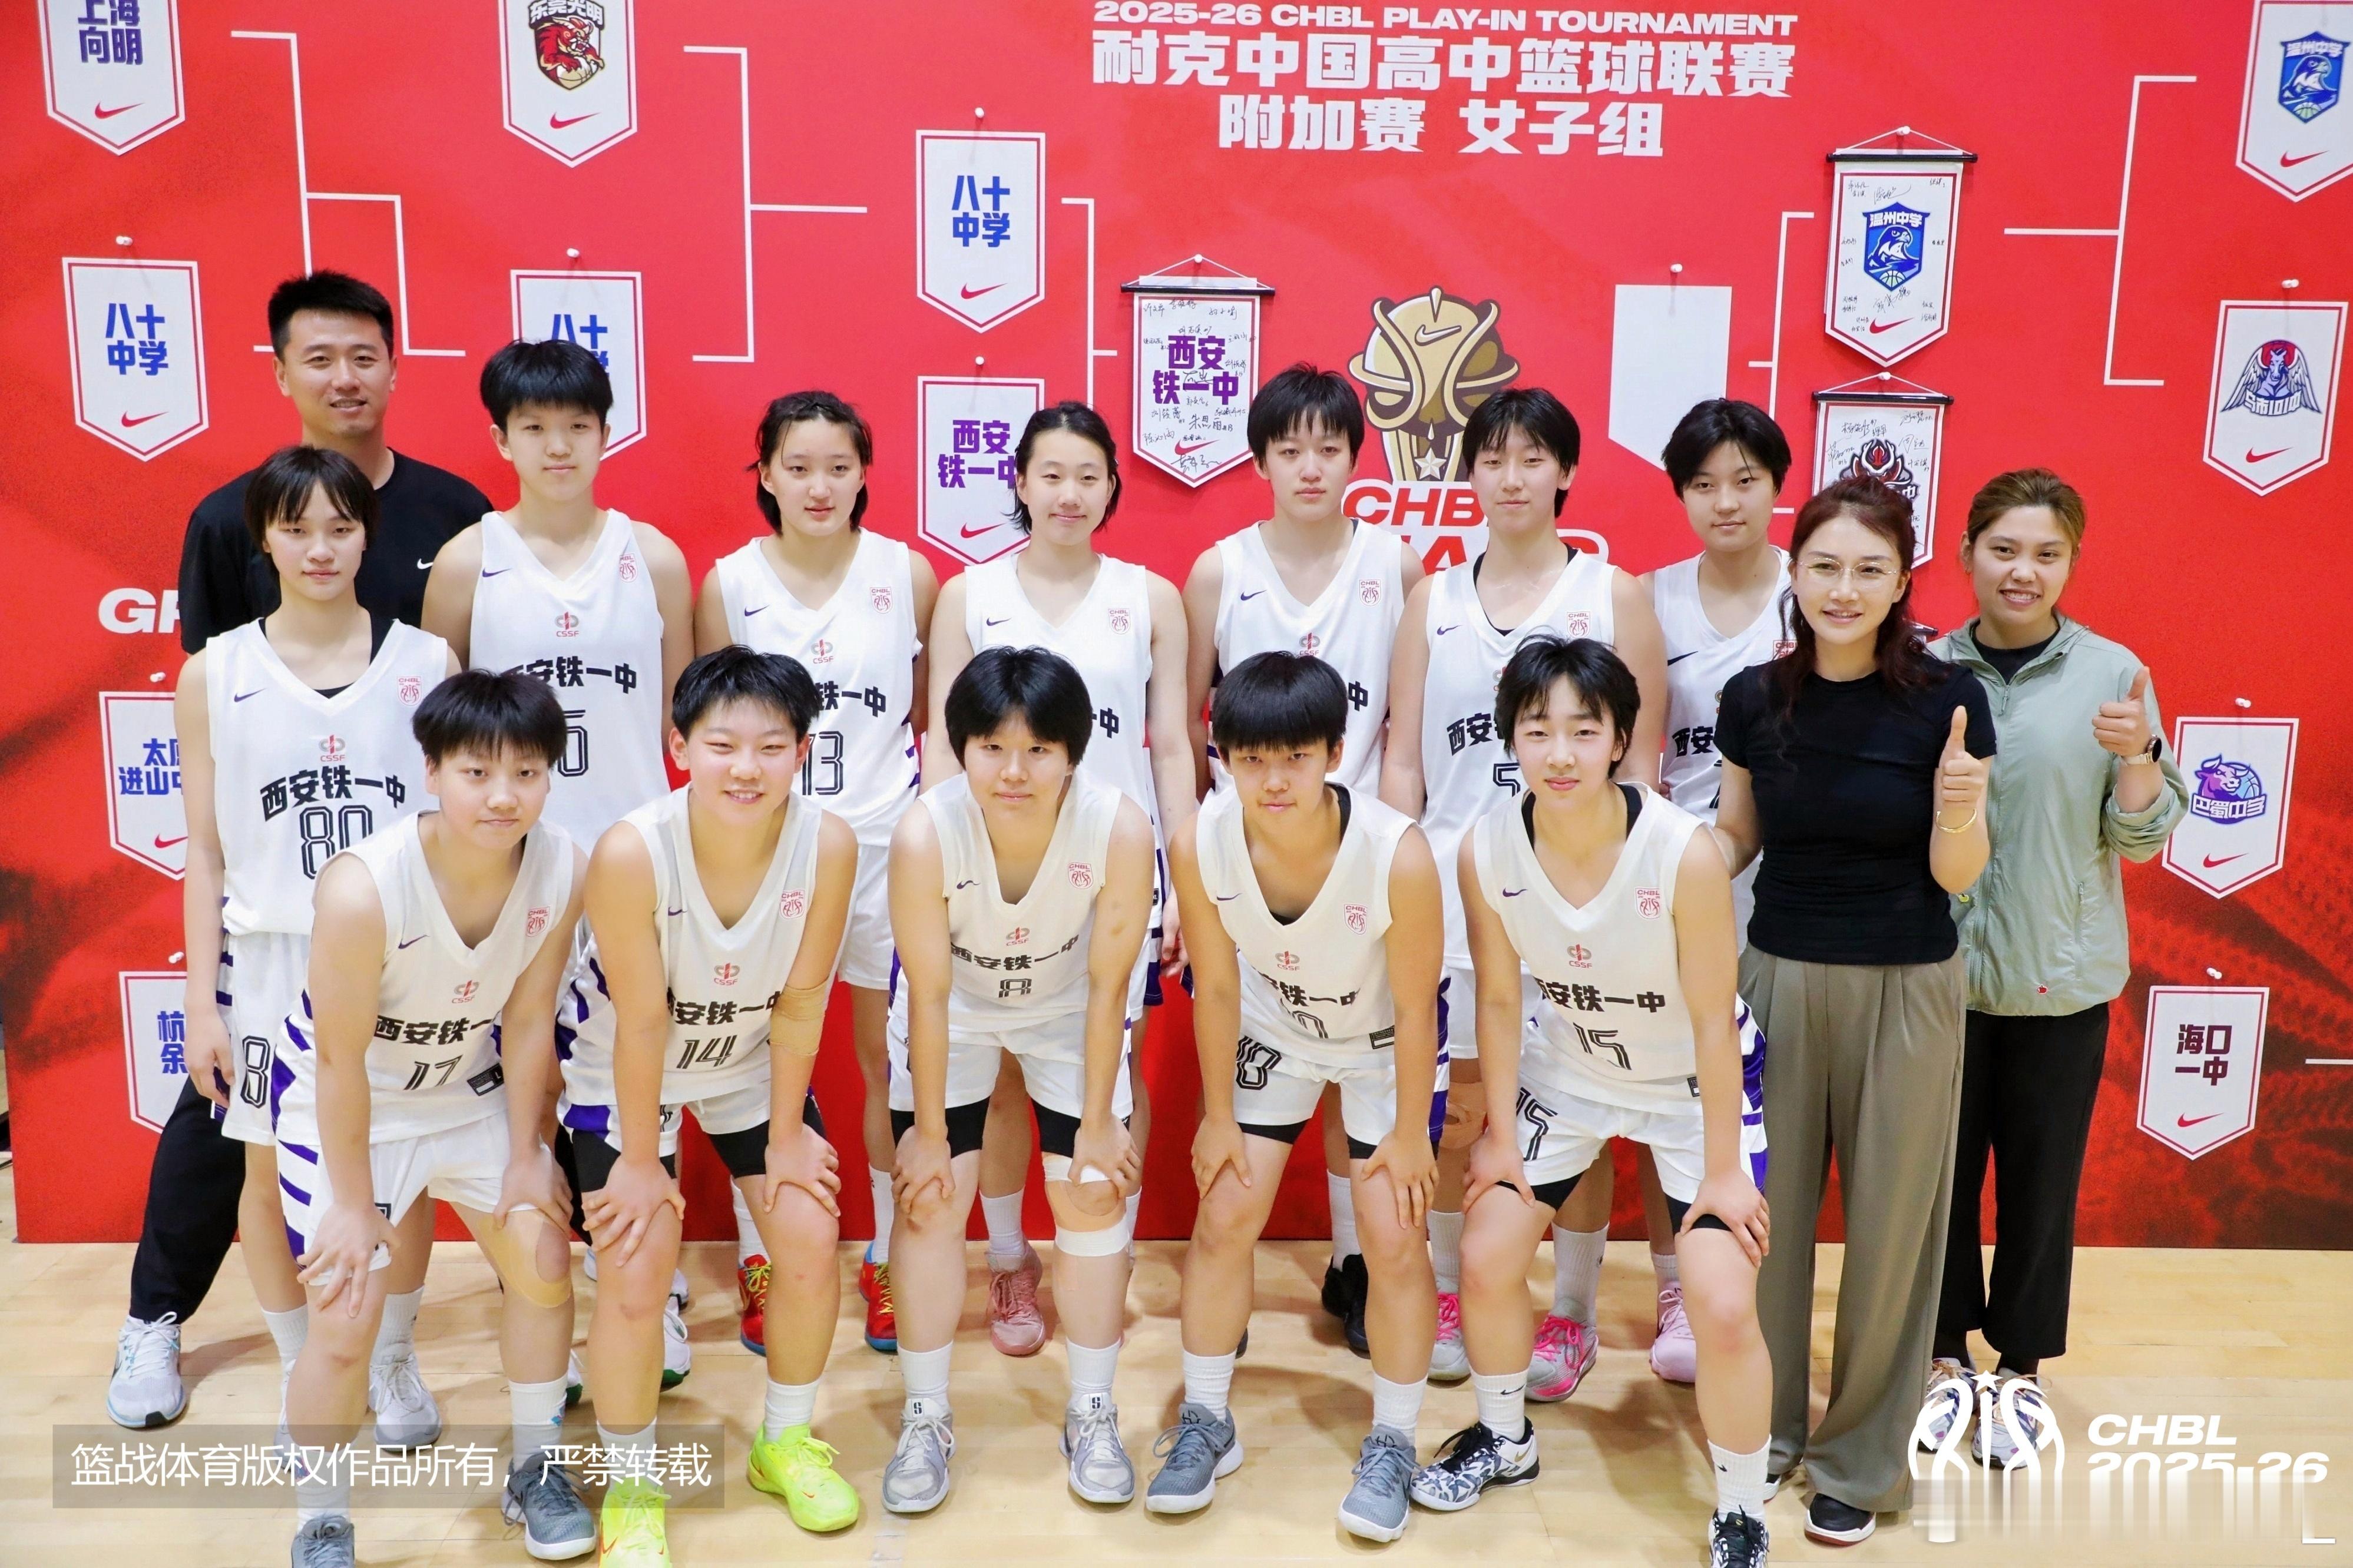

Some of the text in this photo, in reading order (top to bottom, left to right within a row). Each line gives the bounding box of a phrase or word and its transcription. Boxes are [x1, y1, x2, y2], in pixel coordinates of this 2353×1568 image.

[530, 0, 604, 26] 东莞光明
[1094, 1, 1798, 37] 2025-26 CHBL PLAY-IN TOURNAMENT
[79, 26, 143, 65] 向明
[1093, 29, 1796, 97] 耐克中国高中篮球联赛
[1219, 94, 1663, 157] 附加赛 女子组
[952, 175, 1011, 211] 八十
[952, 212, 1011, 248] 中学
[1868, 212, 1924, 228] 温州中学
[105, 303, 166, 340] 八十
[551, 314, 608, 349] 八十
[107, 340, 169, 376] 中学
[1168, 335, 1226, 370] 西安
[1153, 369, 1239, 406] 铁一中
[952, 420, 1011, 454] 西安
[802, 731, 844, 796] 13
[259, 765, 406, 823] 西安铁一中
[2193, 796, 2265, 819] 巴蜀中学
[299, 804, 373, 880] 80
[714, 978, 739, 986] CSSF
[1568, 960, 1593, 969] CSSF
[452, 995, 475, 1004] CSSF
[676, 1035, 737, 1070] 14
[1573, 1022, 1633, 1071] 15
[2176, 1024, 2232, 1055] 海口
[403, 1054, 464, 1091] 17
[2175, 1056, 2229, 1086] 一中
